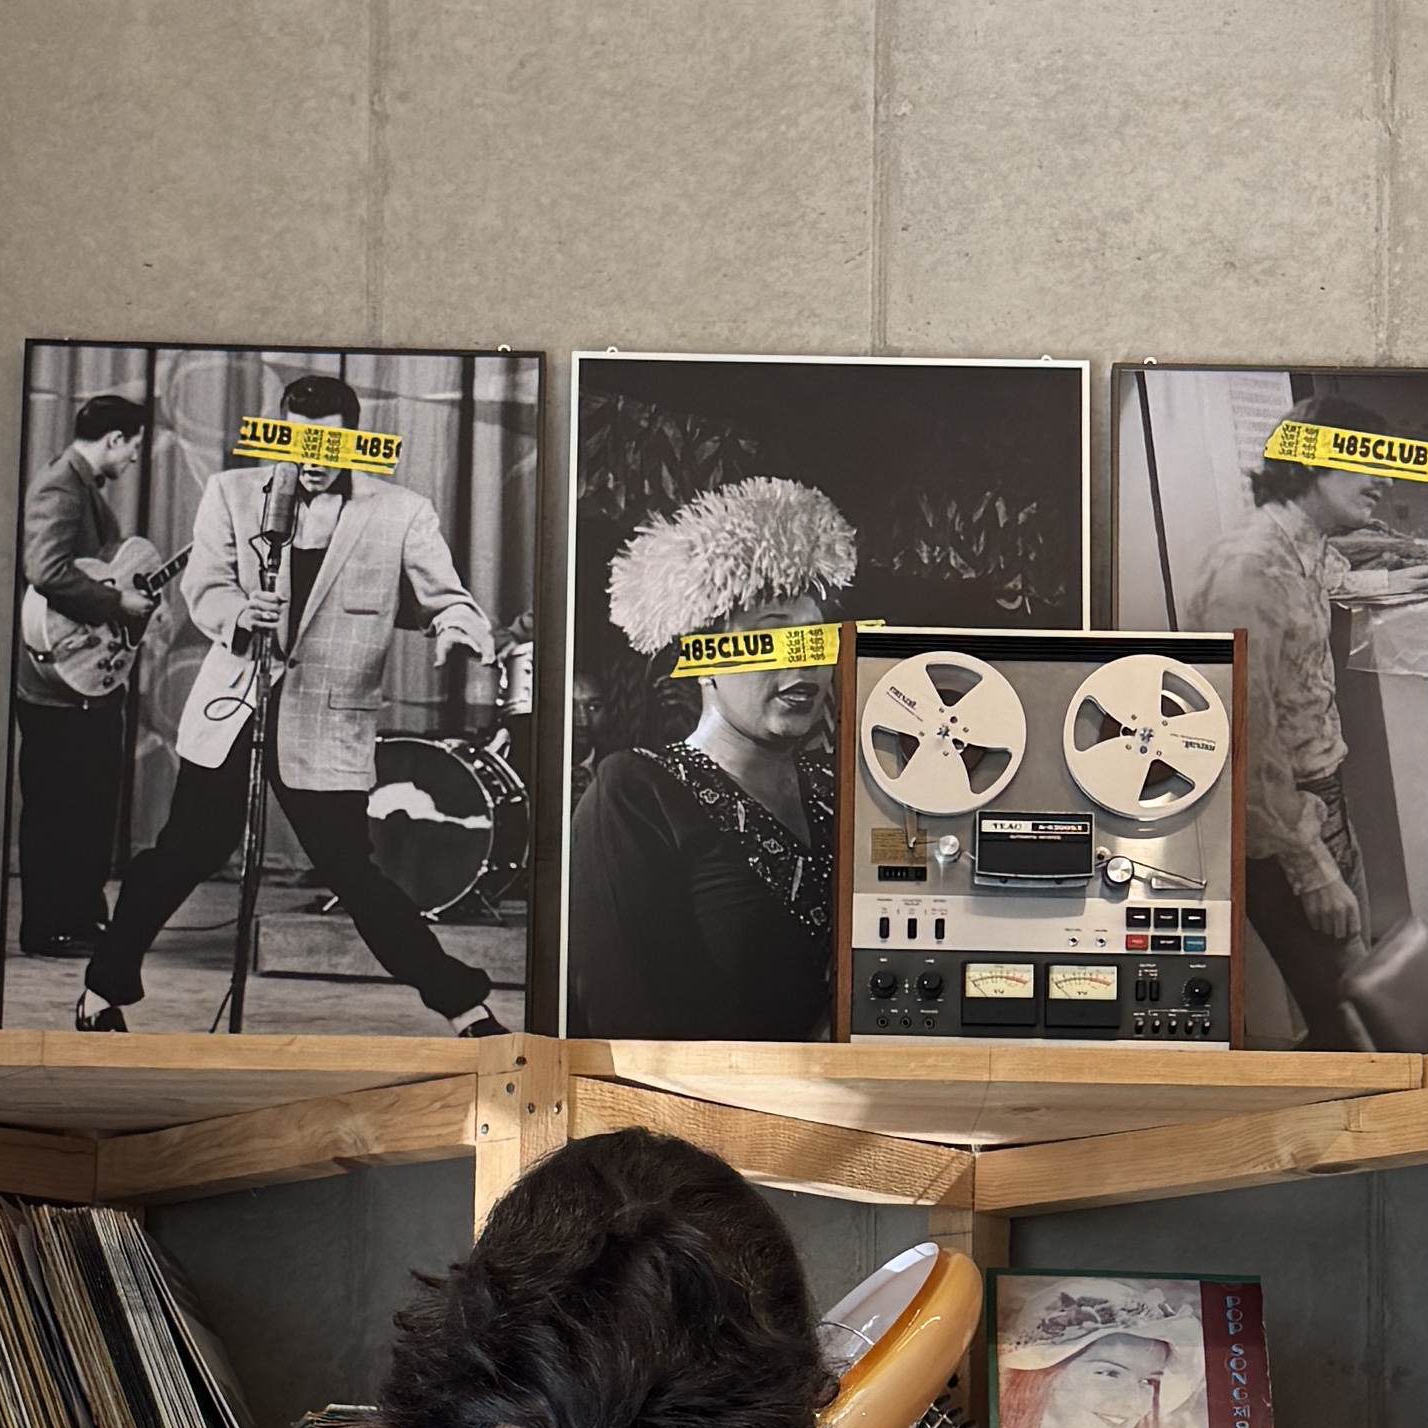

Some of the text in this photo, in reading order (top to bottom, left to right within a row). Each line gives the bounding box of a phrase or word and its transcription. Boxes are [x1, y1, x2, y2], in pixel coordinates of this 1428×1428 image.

[1333, 433, 1428, 465] 485CLUB
[1226, 1295, 1243, 1335] POP
[1230, 1343, 1248, 1401] SONG
